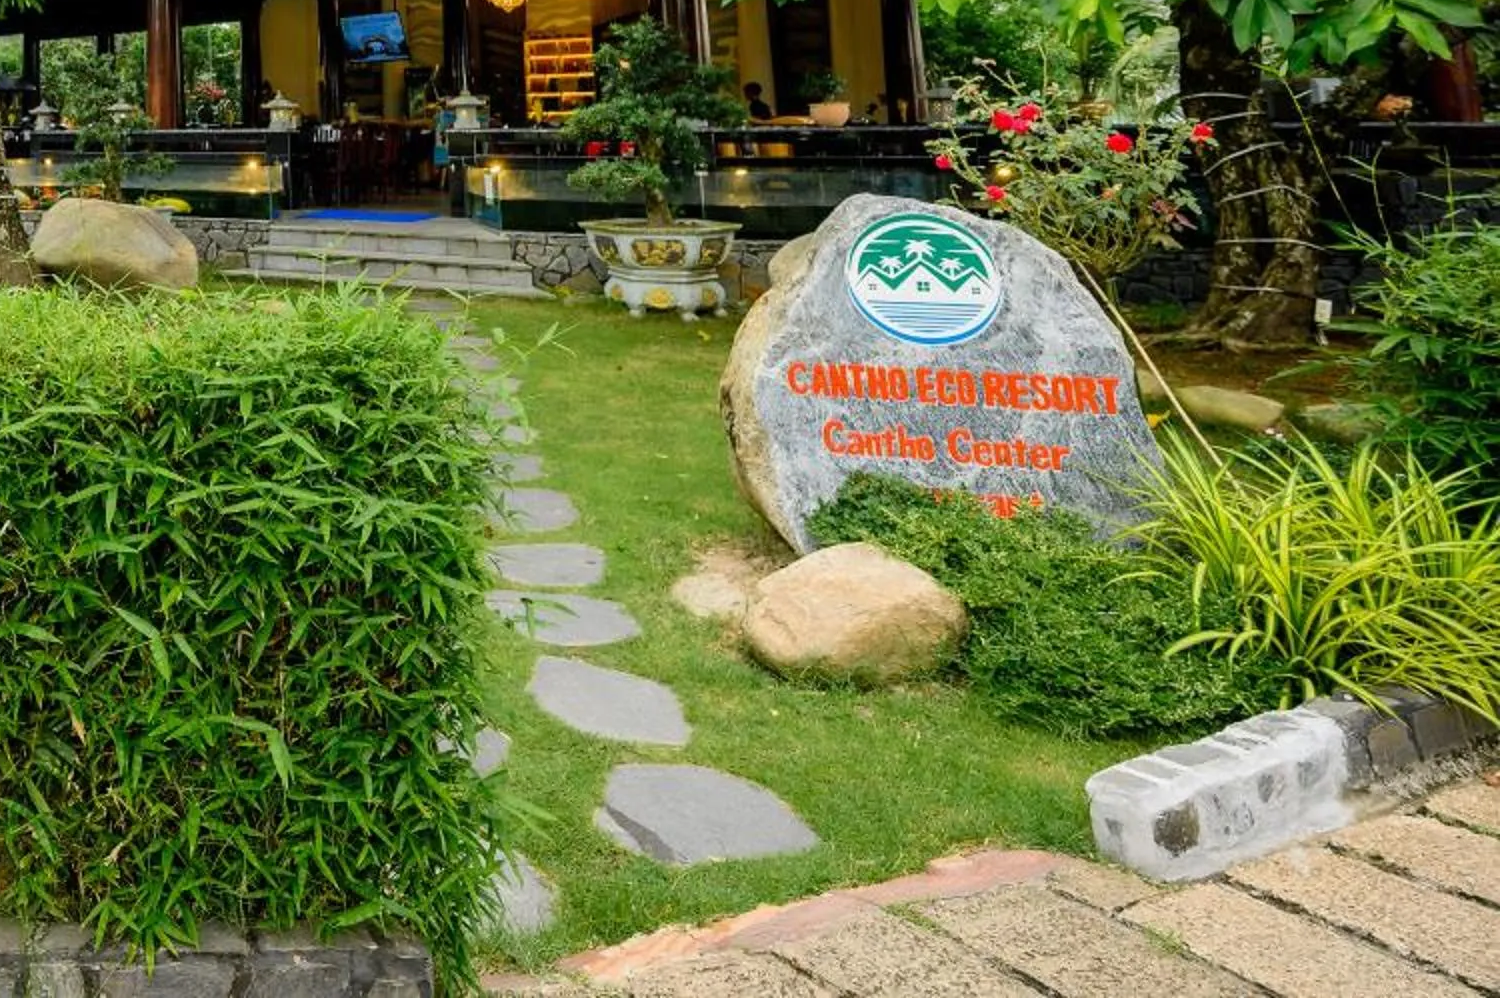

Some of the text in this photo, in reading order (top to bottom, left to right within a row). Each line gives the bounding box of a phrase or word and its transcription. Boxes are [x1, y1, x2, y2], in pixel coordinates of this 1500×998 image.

[786, 361, 1120, 415] CANTHO ECO RESORT
[822, 417, 1071, 472] Cantho Center
